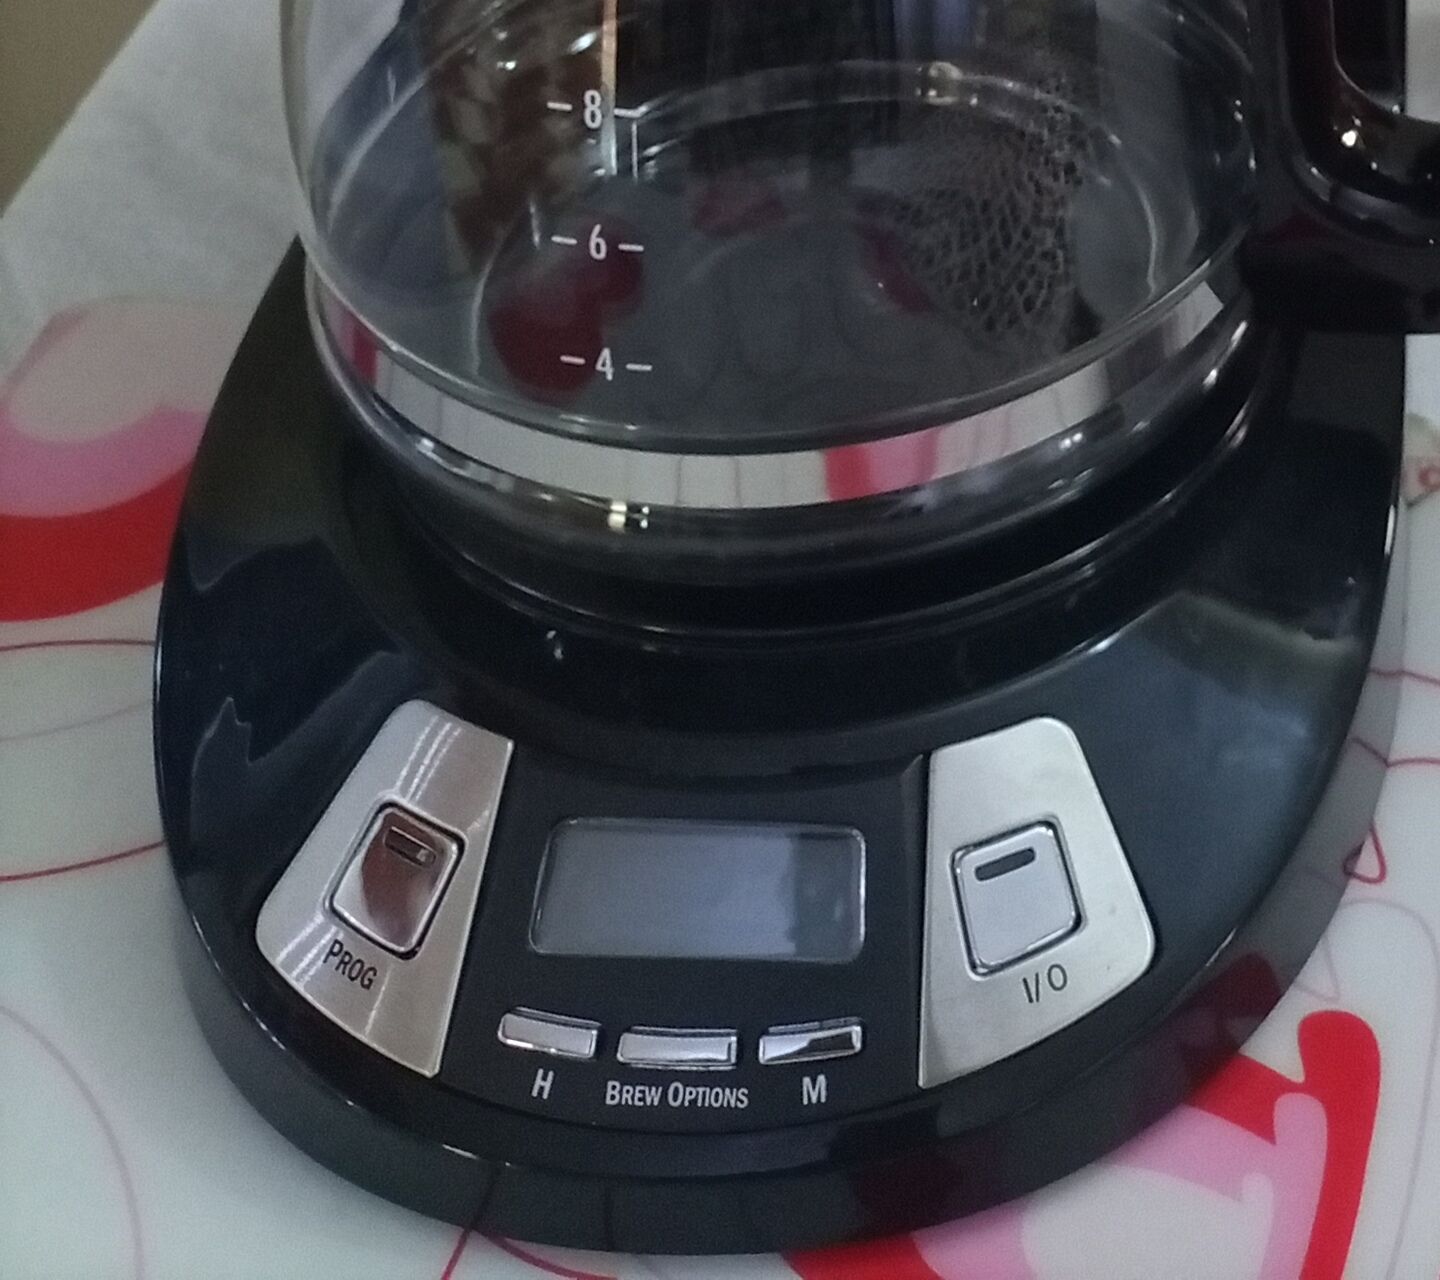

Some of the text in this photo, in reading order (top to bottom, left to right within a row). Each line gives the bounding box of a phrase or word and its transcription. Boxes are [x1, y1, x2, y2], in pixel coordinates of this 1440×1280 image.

[583, 89, 603, 130] 8
[588, 223, 608, 261] 6
[595, 347, 615, 382] 4
[322, 938, 378, 991] PROG
[530, 1067, 555, 1101] H
[604, 1079, 750, 1110] BREW OPTIONS
[801, 1073, 828, 1106] M
